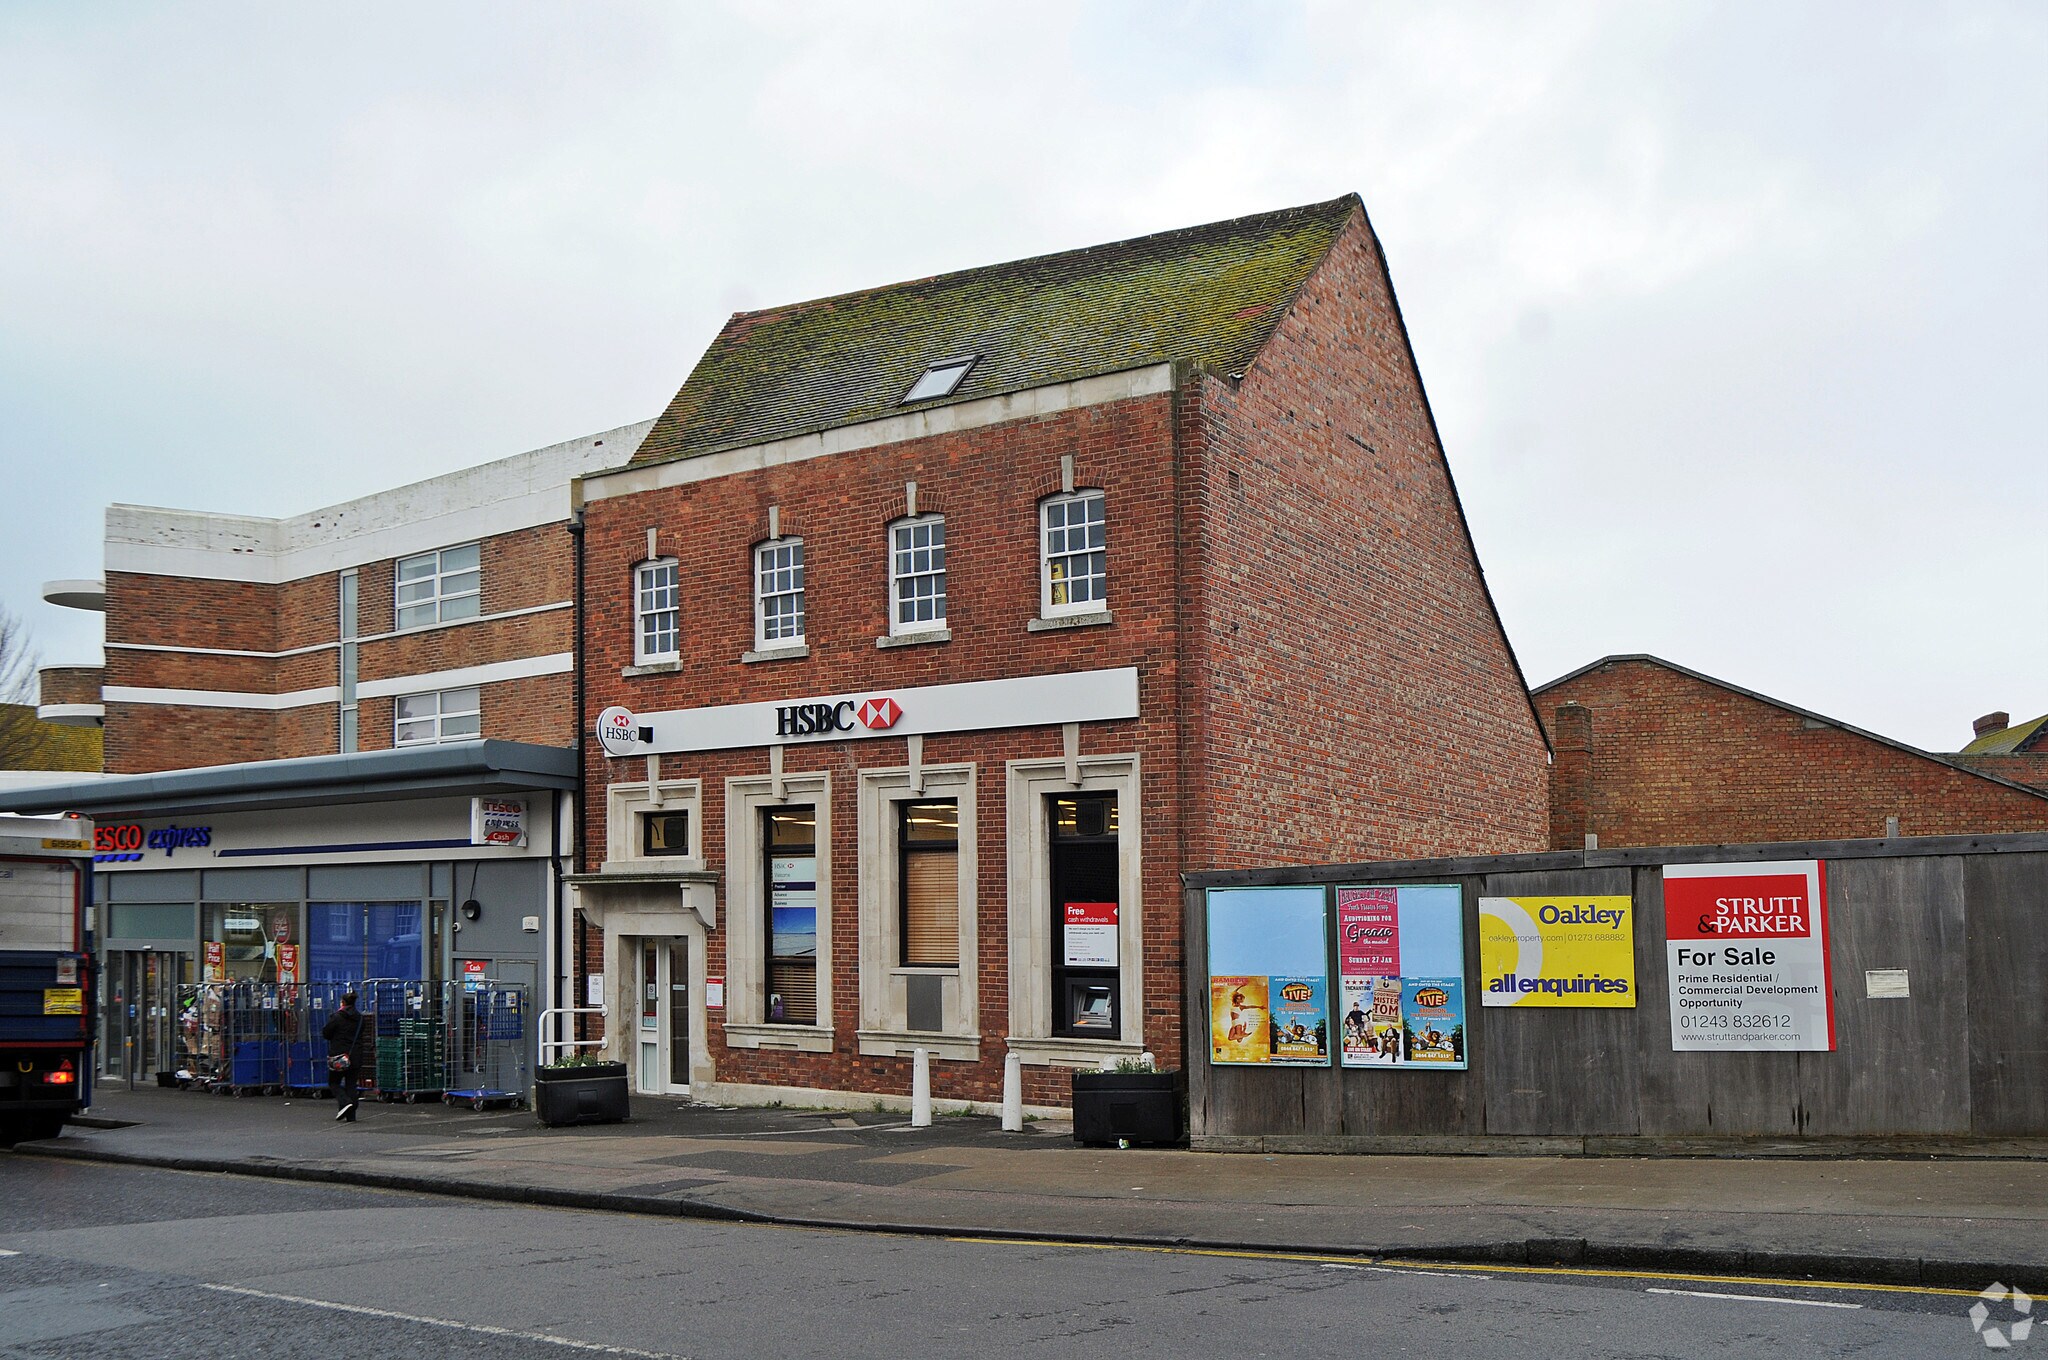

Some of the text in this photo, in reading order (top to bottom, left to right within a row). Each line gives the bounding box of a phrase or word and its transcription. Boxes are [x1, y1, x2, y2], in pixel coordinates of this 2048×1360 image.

[775, 700, 855, 736] HSBC
[605, 727, 637, 742] HSBC
[484, 802, 521, 813] TESCO
[485, 819, 519, 828] express
[94, 824, 212, 857] ESCO express
[1067, 906, 1085, 915] Free
[1715, 896, 1801, 915] STRUTT
[1538, 904, 1625, 929] Oakley
[1345, 922, 1393, 943] Grease
[1488, 933, 1563, 943] oakleyproperty.com
[1568, 934, 1593, 942] 01273
[1677, 947, 1776, 966] For Sale
[1678, 974, 1709, 983] Prime
[1712, 973, 1773, 983] Residential
[1282, 989, 1312, 1001] LIVE!
[1678, 985, 1818, 996] Commercial Development
[1373, 996, 1399, 1005] MISTER
[1416, 994, 1447, 1006] LIVE!
[1679, 998, 1743, 1009] Opportunity
[1373, 1003, 1399, 1015] TOM
[1680, 1014, 1791, 1028] 01243 832612
[1681, 1032, 1801, 1042] www.struttandparker.com
